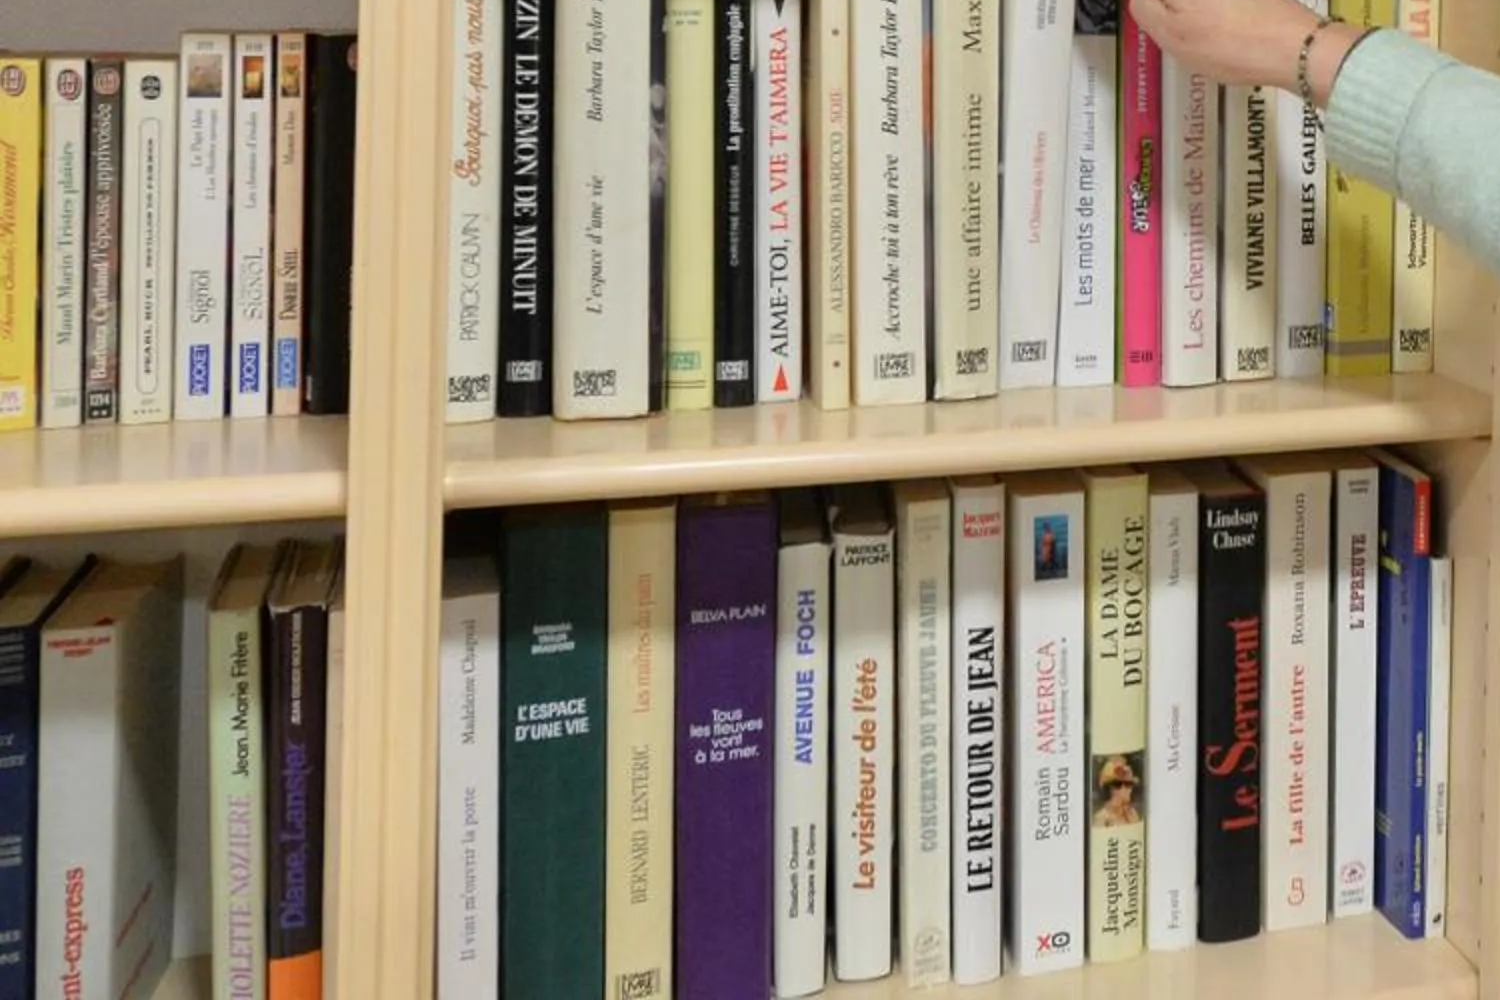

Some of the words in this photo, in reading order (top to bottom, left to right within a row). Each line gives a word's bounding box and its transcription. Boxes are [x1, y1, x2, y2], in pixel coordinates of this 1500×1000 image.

[587, 7, 606, 53] Taylor
[881, 10, 899, 58] Taylor
[963, 0, 982, 53] Max
[1410, 9, 1431, 39] LA
[515, 54, 538, 83] LE
[586, 60, 604, 122] Barbara
[769, 25, 788, 147] T'AIMERA
[881, 65, 898, 136] Barbara
[1183, 72, 1205, 160] Maison
[514, 92, 539, 175] DEMON
[966, 94, 982, 171] intime
[1246, 95, 1267, 207] VILLAMONT
[588, 174, 603, 196] vie
[769, 152, 788, 192] VIE
[884, 153, 899, 189] rêve
[1184, 166, 1205, 196] de
[513, 185, 537, 216] DE
[586, 200, 603, 245] d'une
[770, 199, 788, 231] LA
[884, 194, 900, 218] ton
[963, 181, 981, 258] affaire
[459, 213, 480, 279] CAUVIN
[884, 222, 900, 233] à
[884, 236, 900, 259] toi
[1184, 201, 1205, 302] chemins
[1246, 212, 1265, 291] VIVIANE
[511, 224, 537, 315] MINUIT
[586, 249, 603, 314] L'espace
[967, 268, 981, 311] une
[191, 269, 216, 325] Signol
[459, 280, 480, 342] PATRICK
[771, 239, 791, 357] AIME-TOI,
[884, 262, 900, 340] Accroche
[1183, 308, 1204, 350] Les
[240, 343, 261, 395] POCKET
[1206, 508, 1261, 530] Lindsay
[1211, 530, 1256, 551] Chase
[1290, 492, 1307, 576] Robinson
[840, 554, 891, 568] LAFFONT
[845, 543, 889, 557] PATRICE
[1100, 549, 1120, 620] DAME
[1123, 516, 1145, 638] BOCAGE
[691, 609, 727, 624] BELVA
[728, 603, 767, 620] PLAIN
[796, 588, 817, 655] FOCH
[1290, 581, 1306, 645] Roxana
[967, 626, 996, 694] JEAN
[1100, 628, 1119, 659] LA
[1123, 650, 1142, 687] DU
[516, 697, 586, 723] L'ESPACE
[853, 657, 879, 713] l'été
[1036, 640, 1056, 755] AMERICA
[1205, 615, 1261, 777] Serment
[1290, 665, 1304, 735] l'autre
[515, 720, 562, 744] D'UNE
[564, 718, 591, 737] VIE
[689, 722, 712, 739] les
[712, 717, 764, 737] fleuves
[711, 708, 743, 723] Tous
[794, 668, 815, 765] AVENUE
[853, 718, 877, 753] de
[967, 696, 993, 739] DE
[695, 748, 706, 765] à
[709, 747, 726, 762] la
[728, 745, 761, 760] mer.
[711, 734, 742, 750] vont
[1289, 741, 1304, 766] de
[631, 743, 650, 822] LENTERIC
[967, 744, 994, 856] RETOUR
[1035, 766, 1053, 841] Romain
[1053, 767, 1070, 836] Sardou
[1222, 786, 1258, 830] Le
[1289, 770, 1304, 814] fille
[852, 761, 877, 857] visiteur
[1289, 819, 1303, 847] La
[630, 829, 649, 905] BERNARD
[853, 862, 876, 890] Le
[967, 859, 993, 894] LE
[1103, 838, 1120, 934] Jacqueline
[1122, 840, 1143, 930] Monsigny
